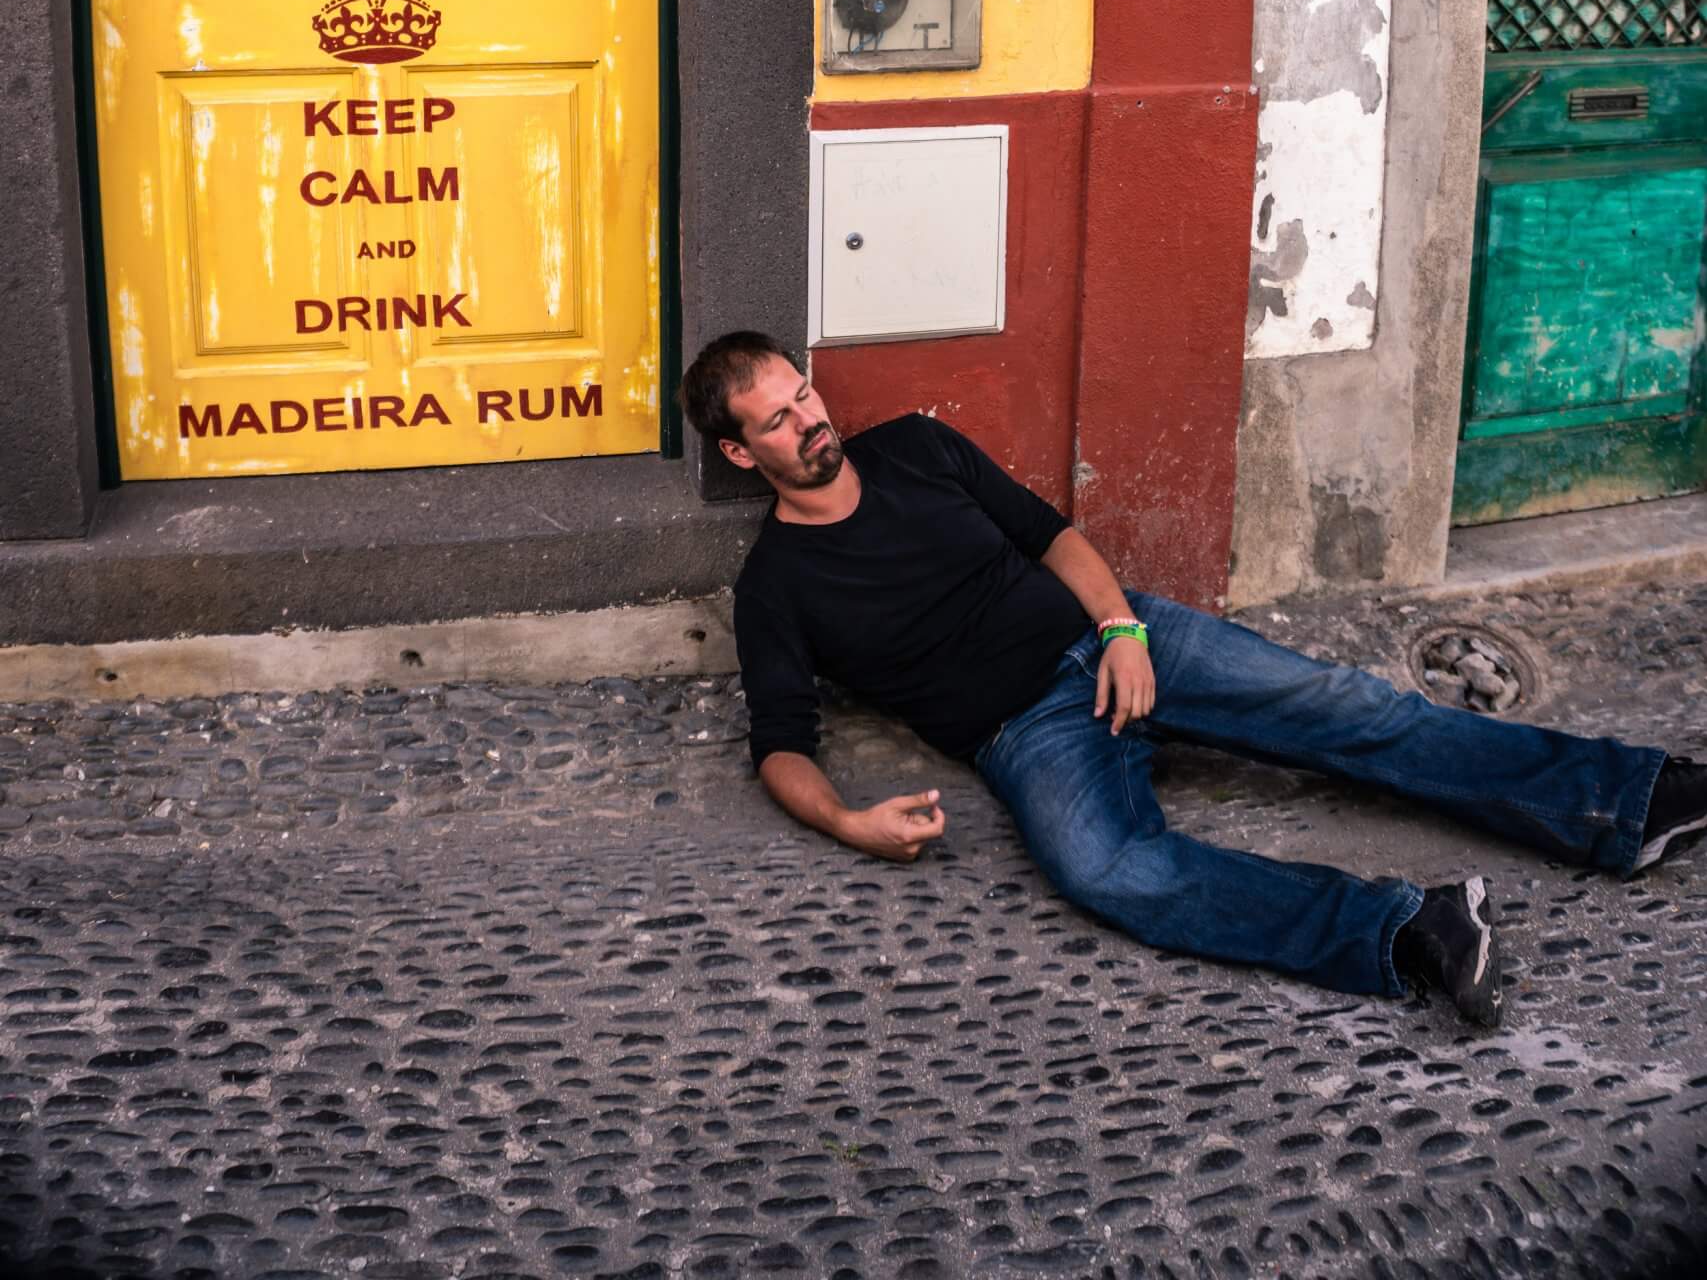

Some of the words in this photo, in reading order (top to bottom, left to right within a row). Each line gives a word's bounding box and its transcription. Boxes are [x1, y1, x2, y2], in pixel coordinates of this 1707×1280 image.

[304, 98, 455, 136] KEEP
[300, 167, 459, 206] CALM
[357, 239, 416, 260] AND
[294, 294, 472, 334] DRINK
[178, 393, 452, 439] MADEIRA
[477, 385, 603, 423] RUM
